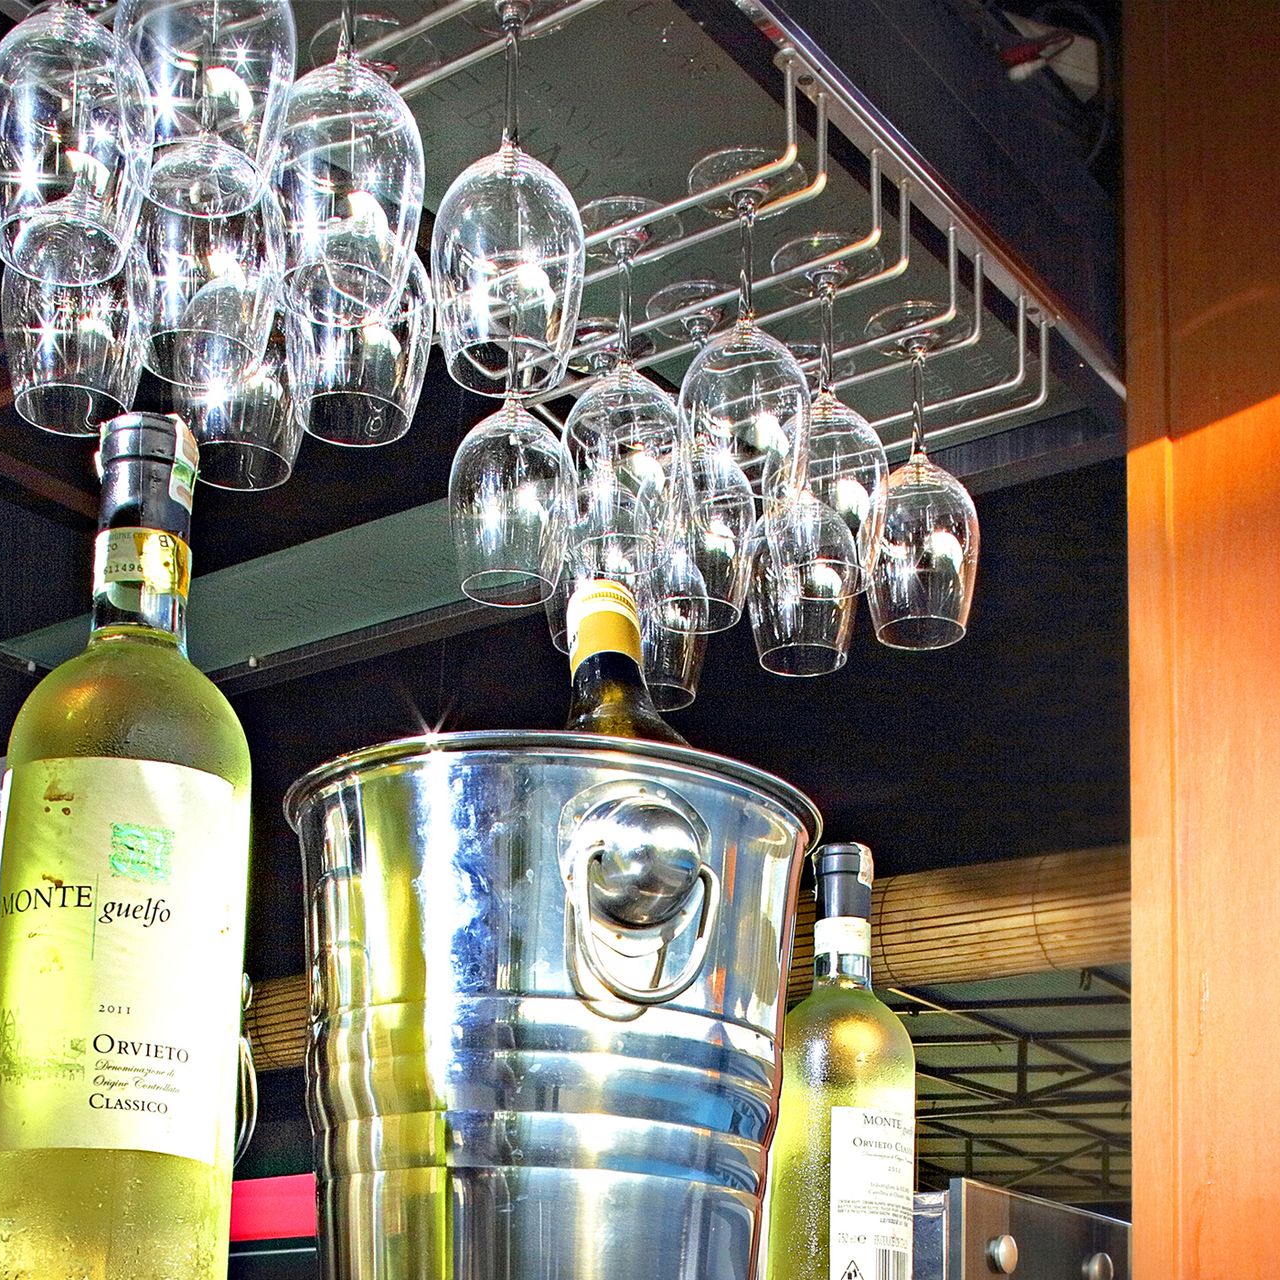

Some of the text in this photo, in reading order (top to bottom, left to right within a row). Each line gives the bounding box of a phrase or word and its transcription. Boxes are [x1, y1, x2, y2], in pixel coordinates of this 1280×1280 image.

[1, 885, 171, 928] MONTE guelfo
[98, 1004, 131, 1015] 2011
[92, 1033, 189, 1063] ORVIETO
[88, 1092, 168, 1115] CLASSICO
[862, 1112, 902, 1130] MONTE
[852, 1136, 893, 1150] ORVIETO
